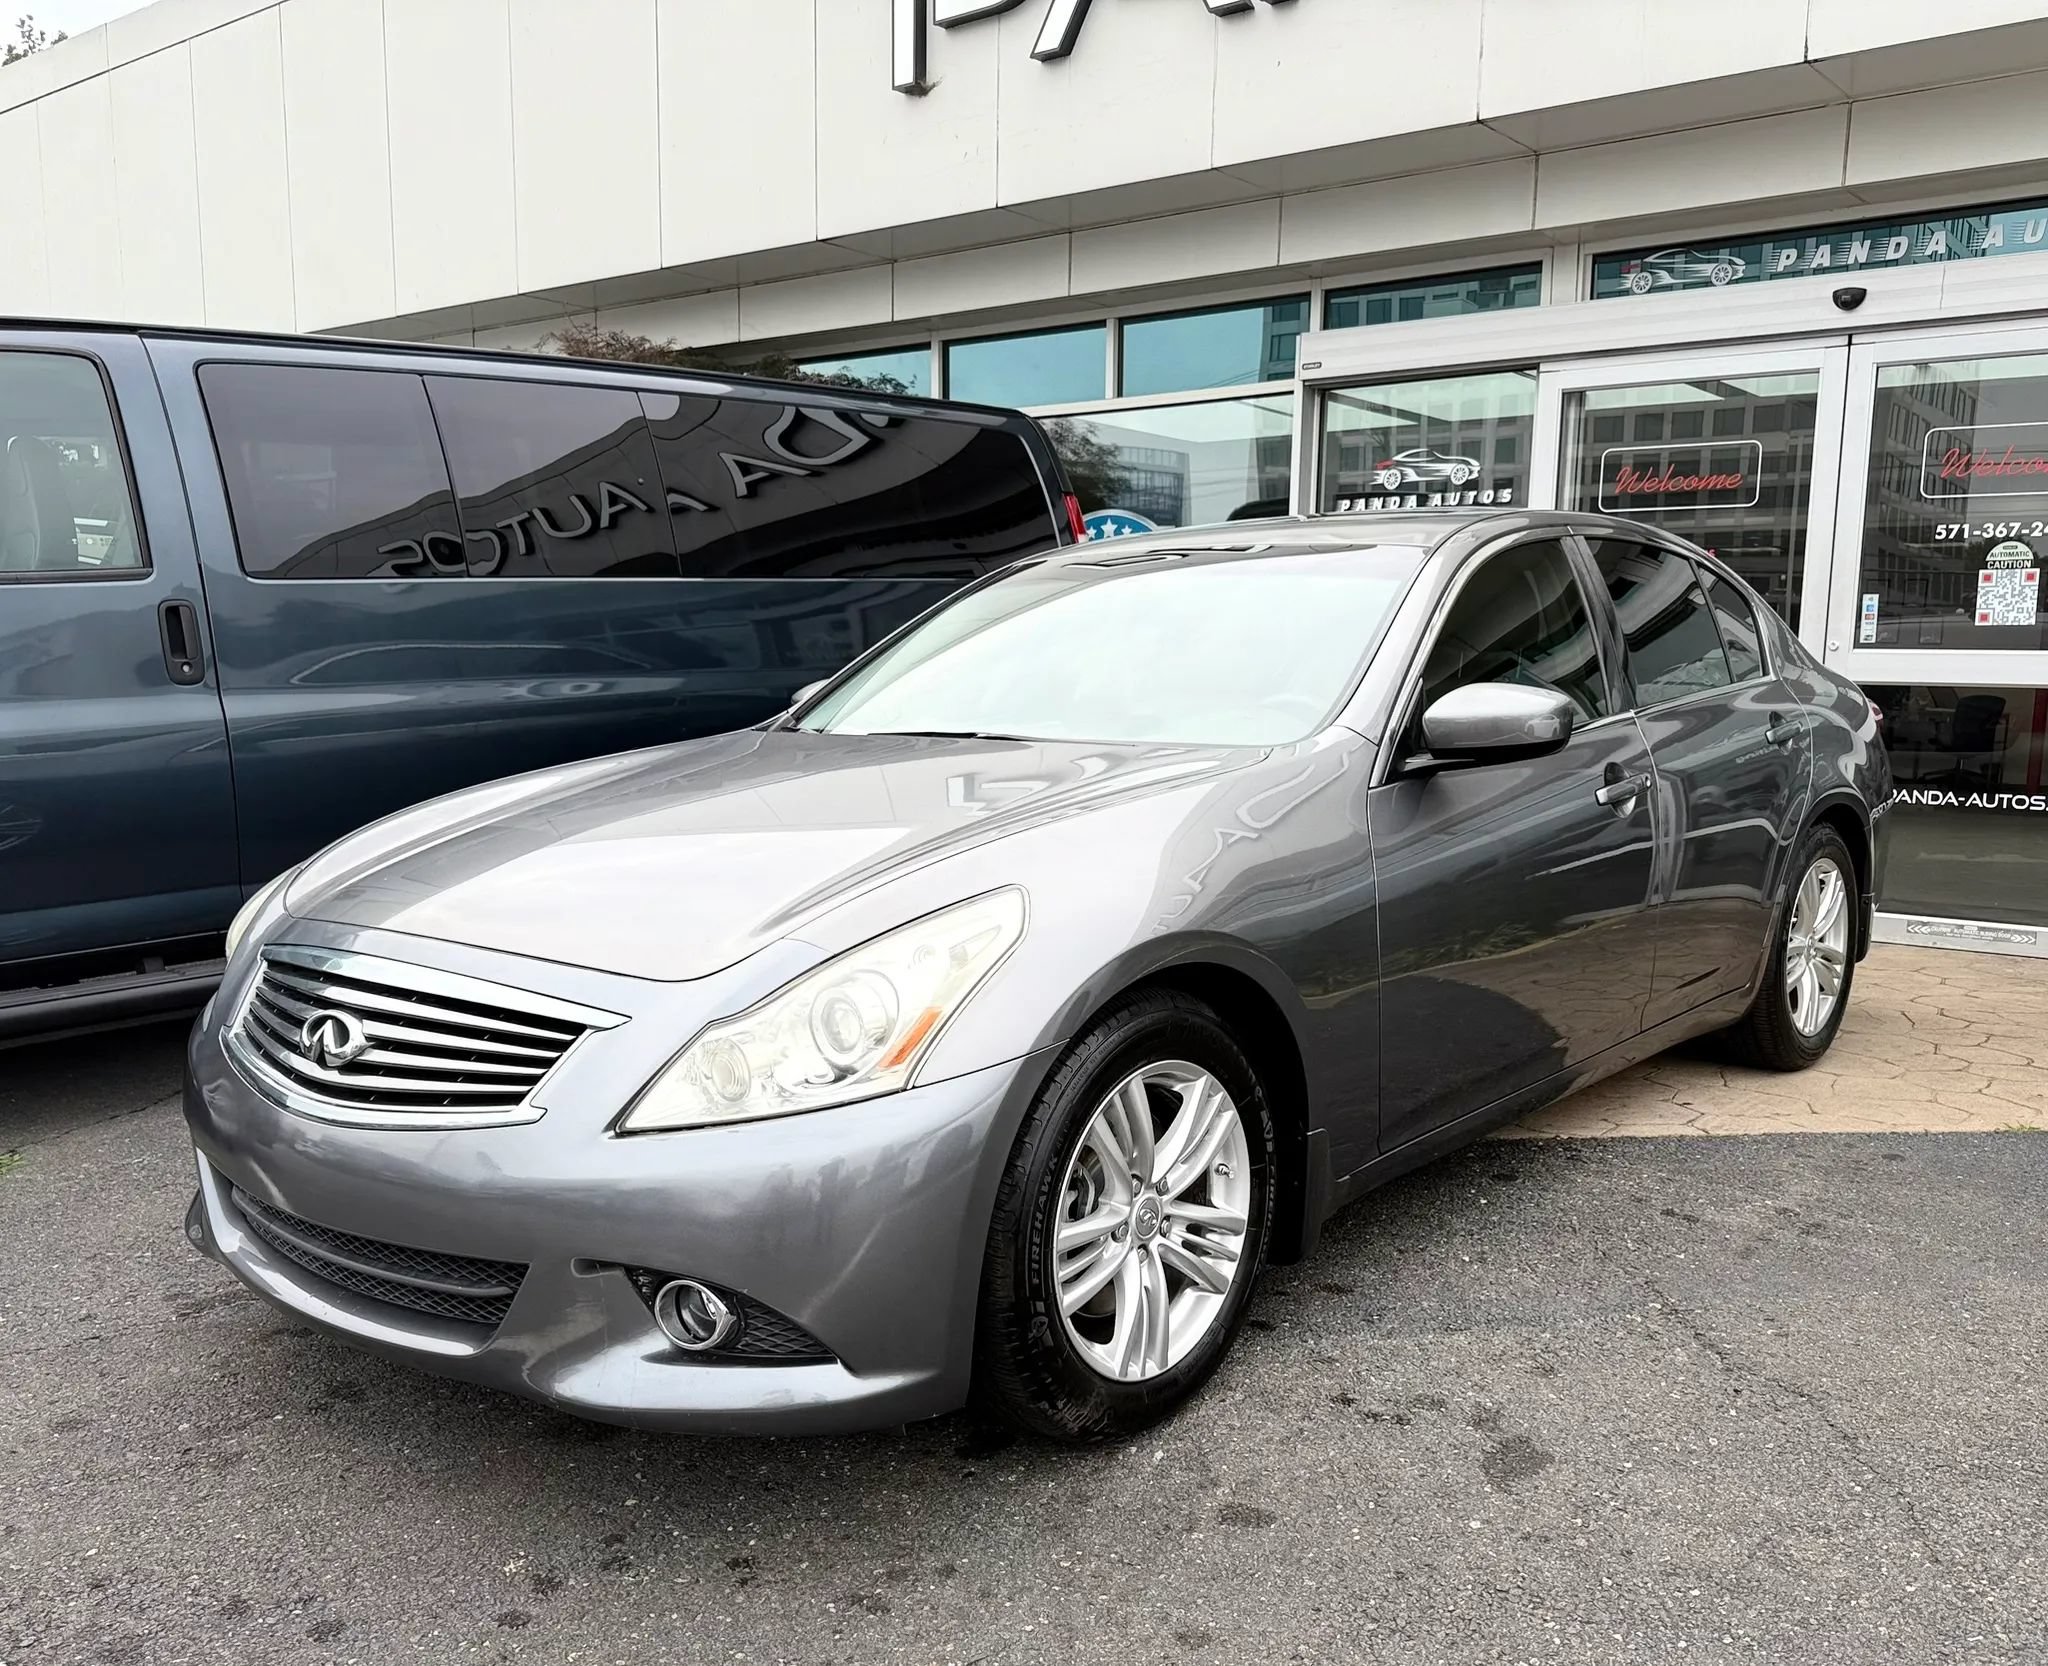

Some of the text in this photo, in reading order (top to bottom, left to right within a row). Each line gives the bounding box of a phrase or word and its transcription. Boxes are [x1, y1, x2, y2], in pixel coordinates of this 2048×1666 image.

[1775, 230, 1947, 273] PANDA
[1940, 444, 2048, 479] Welco
[1615, 463, 1743, 496] Welcome
[1338, 488, 1512, 513] PANDA AUTOS
[1987, 560, 2032, 569] CAUTION
[1990, 550, 2030, 559] AUTOMATIC
[1031, 1153, 1058, 1285] FIREHAWK
